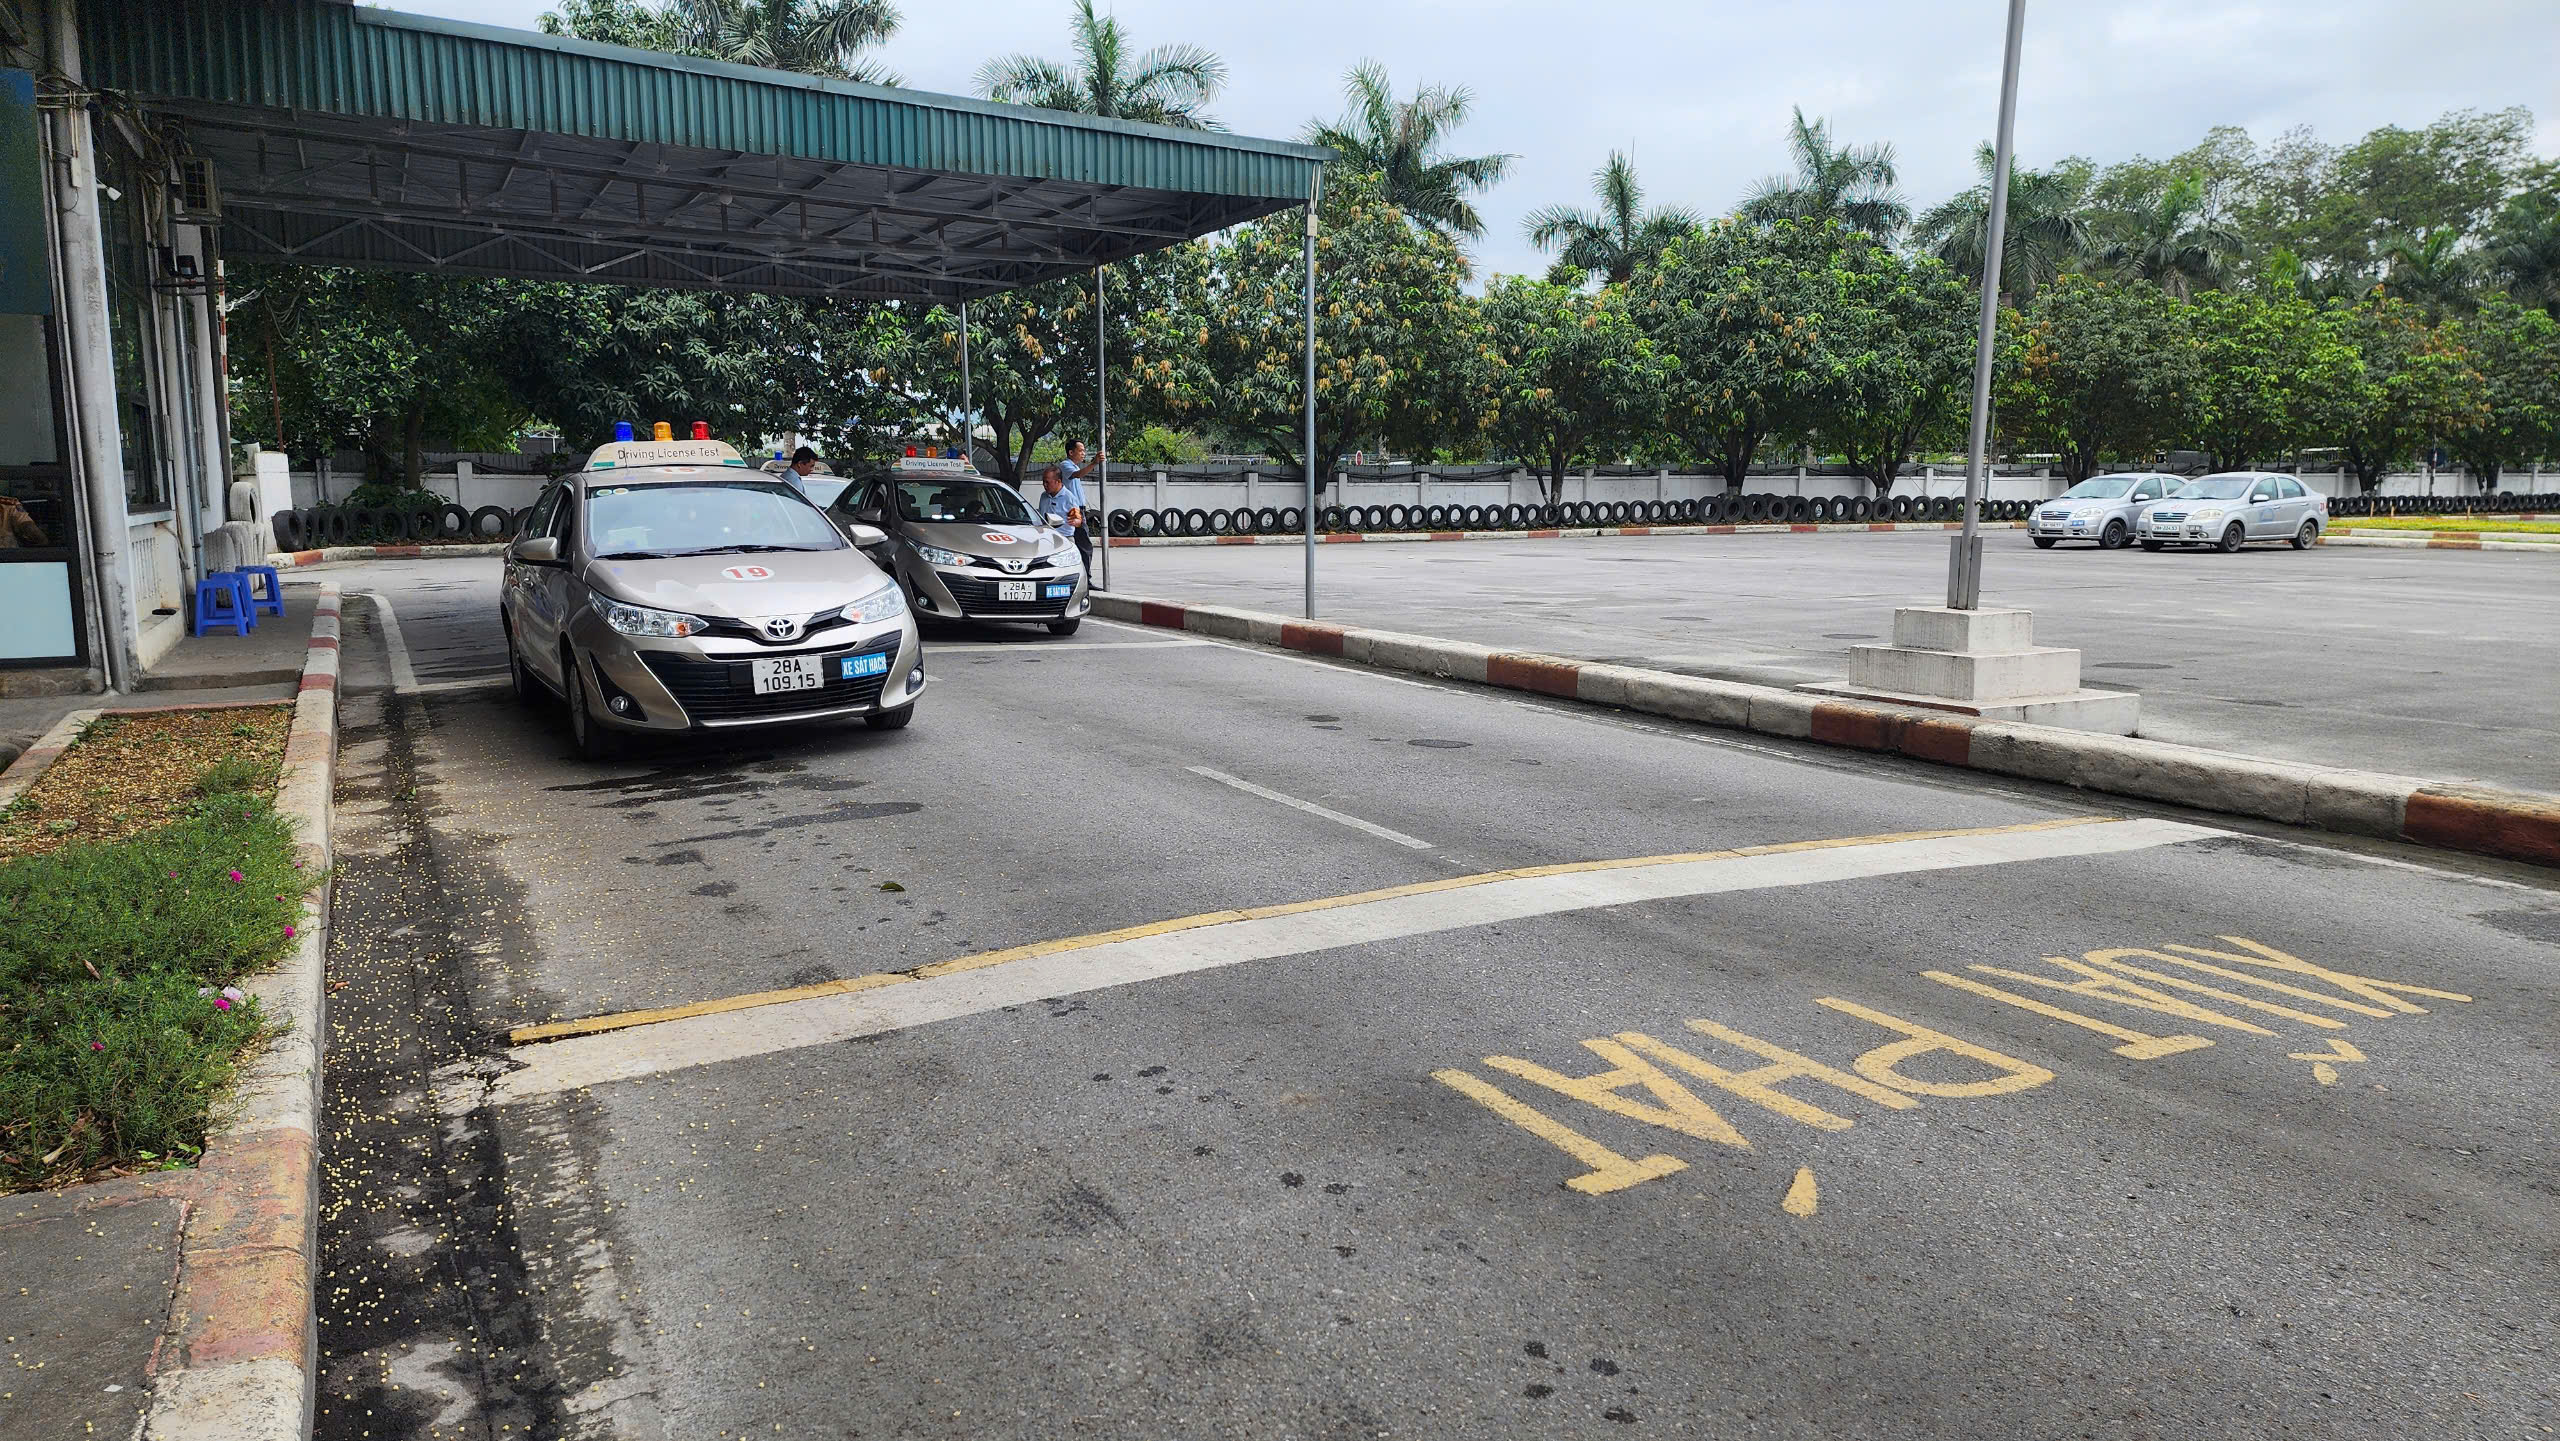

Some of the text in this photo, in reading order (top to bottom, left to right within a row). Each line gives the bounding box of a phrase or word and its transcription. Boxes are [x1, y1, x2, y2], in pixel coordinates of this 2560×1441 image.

[617, 447, 720, 461] Driving License Test
[905, 460, 926, 468] Driving
[950, 460, 962, 468] Test
[726, 567, 769, 579] 19
[1009, 582, 1026, 591] 28A
[1003, 592, 1033, 600] 110.77
[772, 659, 802, 675] 28A
[842, 662, 854, 676] XE
[854, 657, 868, 675] SÁT
[763, 673, 816, 692] 109.15
[1431, 996, 2057, 1218] PHÁT
